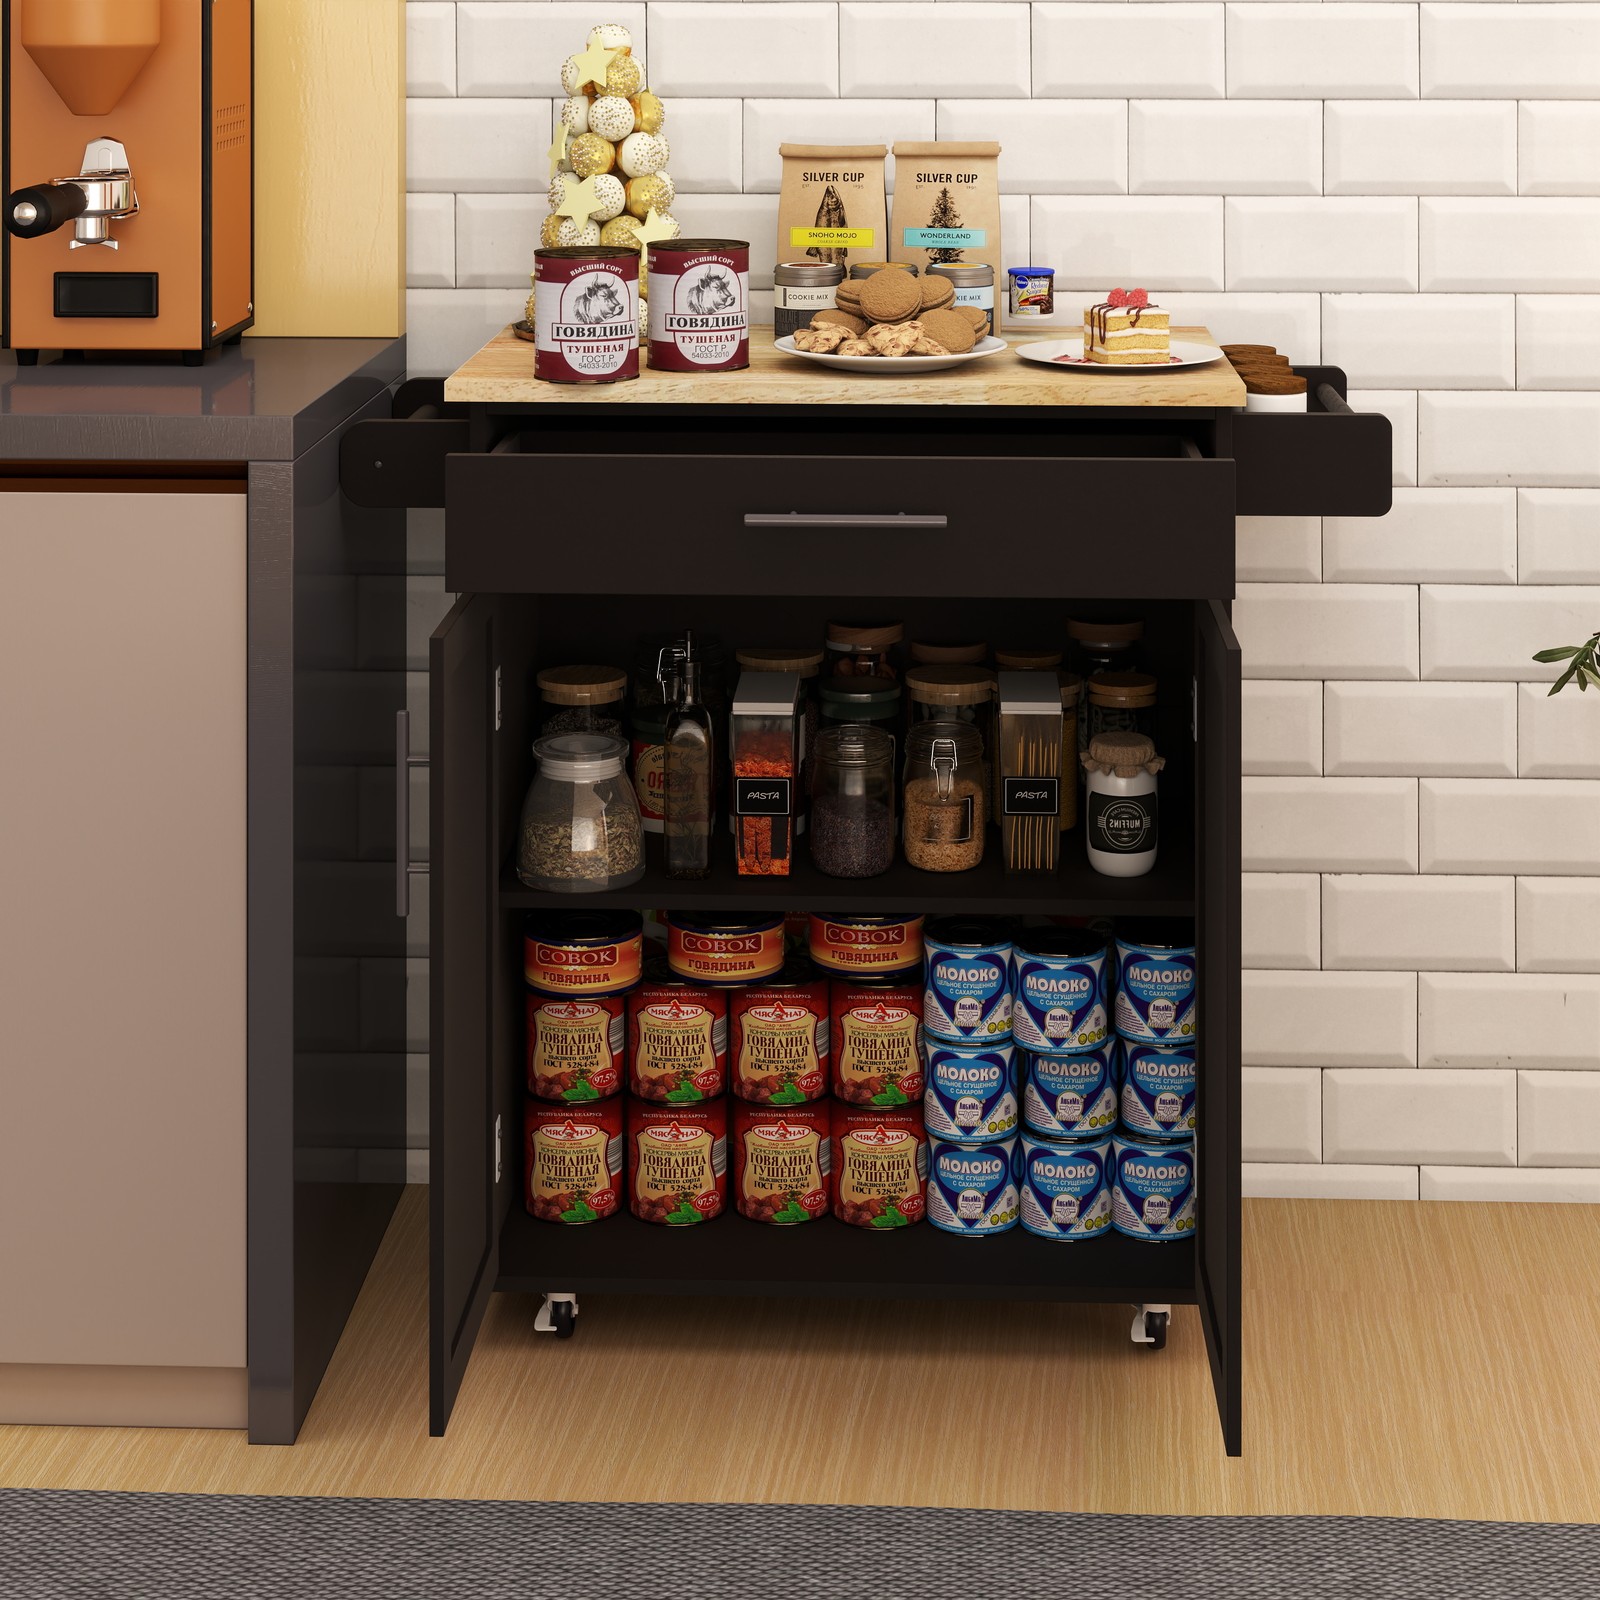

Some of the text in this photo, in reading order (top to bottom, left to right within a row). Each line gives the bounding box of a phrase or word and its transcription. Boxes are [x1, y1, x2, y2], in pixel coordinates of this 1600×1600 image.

[802, 172, 865, 182] SILVER CUP
[916, 173, 978, 183] SILVER CUP
[683, 255, 735, 269] ВЫСШИЙ СОРТ
[570, 263, 624, 277] ВЫСШИЙ СОРТ
[669, 314, 745, 330] ГОВЯДИНА
[556, 323, 634, 339] ГОВЯДИНА
[681, 334, 736, 344] ТУШЕНАЯ
[567, 344, 624, 354] ТУШЕНАЯ
[692, 351, 730, 359] 54033-2010
[695, 344, 727, 353] ГОСТ Р
[579, 361, 618, 369] 54033-2010
[581, 354, 615, 363] ГОСТ Р
[747, 791, 780, 800] PASTA
[1015, 790, 1048, 799] PASTA
[828, 928, 901, 943] СОВОК
[685, 937, 759, 952] СОВОК
[539, 949, 614, 965] СОВОК
[831, 950, 899, 963] ГОВЯДИНА
[688, 959, 756, 972] ГОВЯДИНА
[542, 971, 611, 985] ГОВЯДИНА
[936, 964, 1000, 981] МОЛОКО
[1129, 966, 1193, 983] МОЛОКО
[936, 980, 962, 988] ЦЕЛЬНОЕ
[1026, 975, 1090, 992] МОЛОКО
[1129, 982, 1155, 990] ЦЕЛЬНОЕ
[1026, 991, 1052, 999] ЦЕЛЬНОЕ
[539, 1031, 603, 1047] ГОВЯДИНА
[643, 1032, 707, 1048] ГОВЯДИНА
[746, 1034, 810, 1050] ГОВЯДИНА
[848, 1035, 912, 1051] ГОВЯДИНА
[542, 1043, 601, 1056] ТУШЕНАЯ
[646, 1044, 705, 1057] ТУШЕНАЯ
[749, 1046, 808, 1059] ТУШЕНАЯ
[851, 1047, 910, 1060] ТУШЕНАЯ
[543, 1059, 563, 1068] ГОСТ
[647, 1060, 667, 1069] ГОСТ
[750, 1062, 770, 1071] ГОСТ
[852, 1063, 872, 1072] ГОСТ
[1037, 1058, 1101, 1075] МОЛОКО
[936, 1065, 1000, 1082] МОЛОКО
[1037, 1074, 1063, 1082] ЦЕЛЬНОЕ
[1136, 1076, 1162, 1084] ЦЕЛЬНОЕ
[936, 1081, 962, 1089] ЦЕЛЬНОЕ
[537, 1152, 601, 1168] ГОВЯДИНА
[643, 1154, 707, 1170] ГОВЯДИНА
[750, 1153, 814, 1169] ГОВЯДИНА
[848, 1157, 912, 1173] ГОВЯДИНА
[939, 1156, 1003, 1173] МОЛОКО
[540, 1164, 599, 1177] ТУШЕНАЯ
[646, 1166, 705, 1179] ТУШЕНАЯ
[753, 1165, 812, 1178] ТУШЕНАЯ
[851, 1169, 910, 1182] ТУШЕНАЯ
[939, 1172, 965, 1180] ЦЕЛЬНОЕ
[1033, 1161, 1097, 1178] МОЛОКО
[1124, 1162, 1188, 1179] МОЛОКО
[541, 1180, 561, 1189] ГОСТ
[647, 1182, 667, 1191] ГОСТ
[754, 1181, 774, 1190] ГОСТ
[1033, 1177, 1059, 1185] ЦЕЛЬНОЕ
[1124, 1178, 1150, 1186] ЦЕЛЬНОЕ
[852, 1185, 872, 1194] ГОСТ
